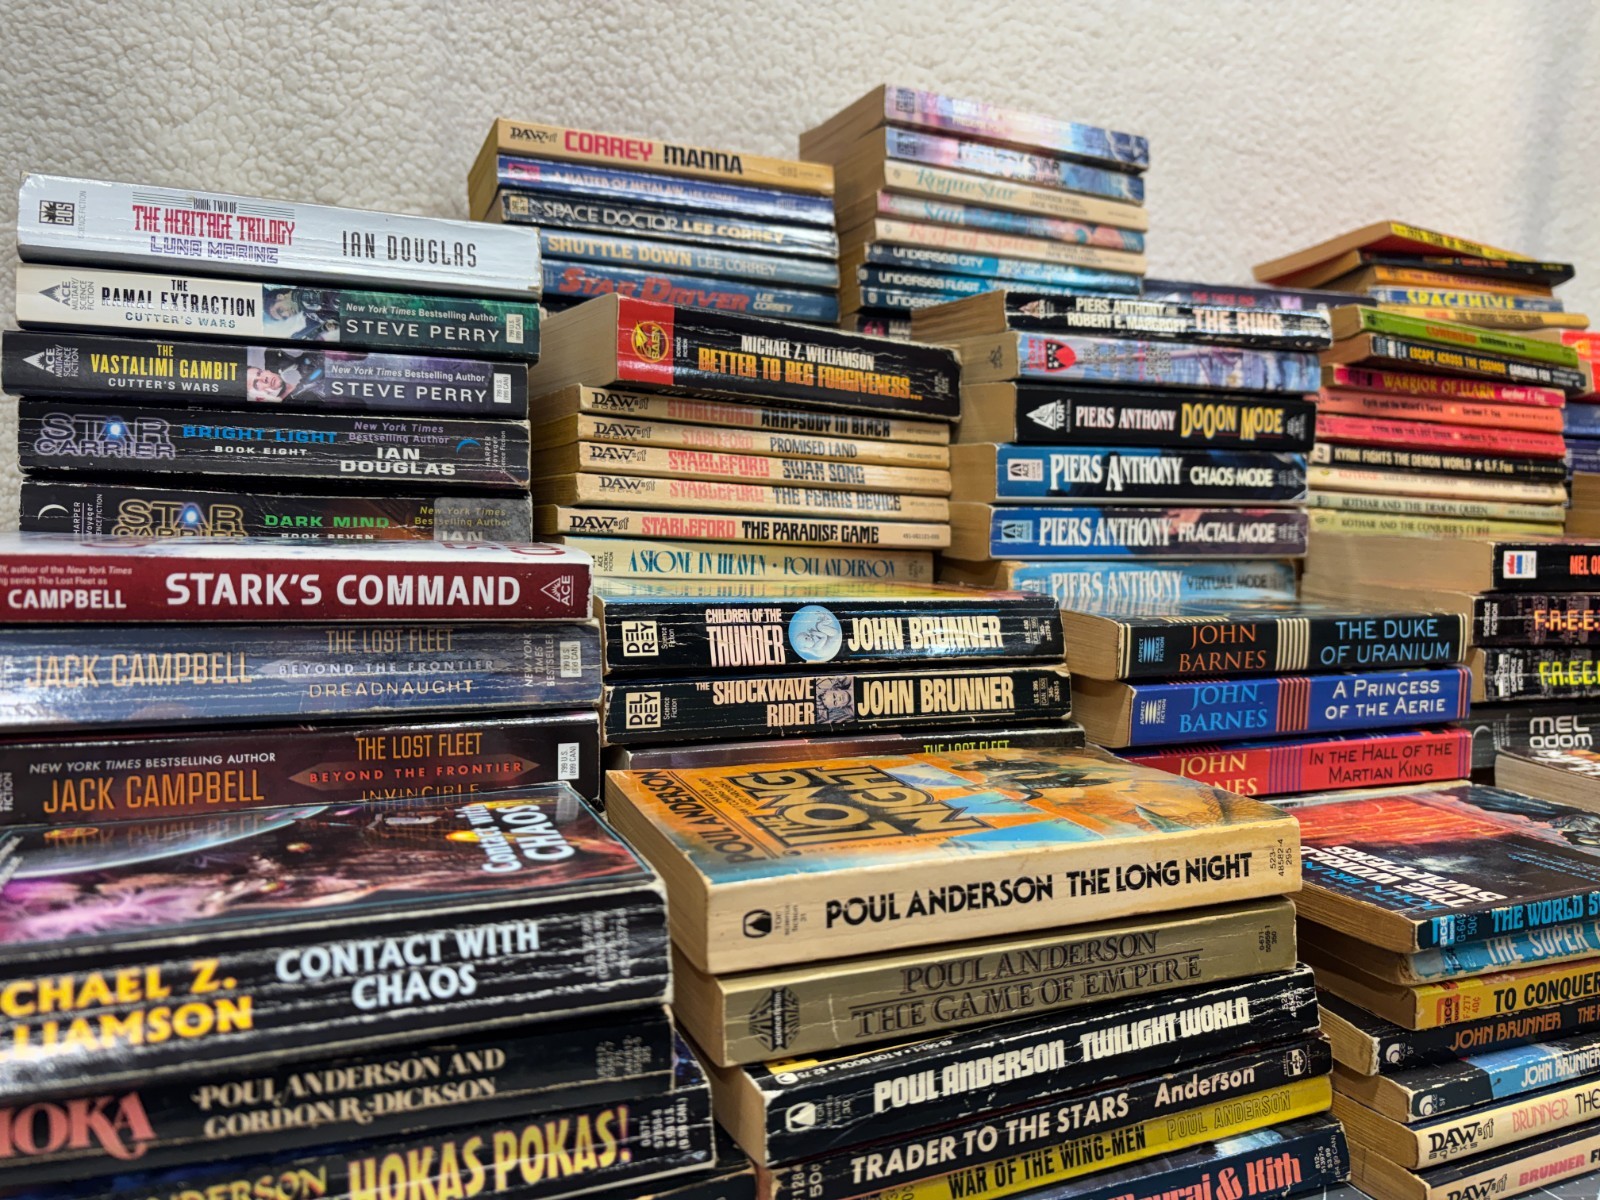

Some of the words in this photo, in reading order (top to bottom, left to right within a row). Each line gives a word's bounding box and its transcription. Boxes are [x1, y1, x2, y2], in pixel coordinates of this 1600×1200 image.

[564, 130, 654, 162] CORREY
[663, 145, 743, 174] MANNA
[213, 199, 226, 212] TWO
[226, 201, 238, 214] OF
[132, 204, 161, 233] THE
[164, 207, 233, 240] HERITAGE
[237, 215, 296, 246] TRILOGY
[543, 201, 599, 223] SPACE
[603, 209, 678, 232] DOCTOR
[682, 220, 714, 236] LEE
[716, 225, 785, 244] CORREY
[150, 235, 202, 257] LUNA
[207, 241, 279, 264] MARINE
[342, 230, 376, 259] IAN
[387, 235, 478, 268] DOUGLAS
[547, 235, 633, 260] SHUTTLE
[637, 245, 692, 267] DOWN
[697, 256, 723, 271] LEE
[725, 260, 777, 276] CORREY
[62, 281, 71, 306] ACE
[171, 279, 188, 292] THE
[160, 291, 256, 318] EXTRACTION
[345, 302, 366, 313] New
[368, 304, 387, 315] York
[390, 306, 416, 317] Times
[418, 308, 466, 322] Bestselling
[468, 311, 498, 323] Author
[125, 312, 193, 326] CUTTER'S
[198, 316, 236, 329] WARS
[346, 319, 419, 338] STEVE
[430, 324, 500, 343] PERRY
[1192, 309, 1231, 332] THE
[1236, 312, 1284, 336] RING
[156, 344, 174, 357] THE
[651, 326, 660, 359] BAEN
[741, 335, 792, 359] MICHAEL
[794, 344, 805, 361] Z.
[806, 345, 875, 371] WILLIAMSON
[90, 353, 174, 377] VASTALIMI
[179, 360, 238, 381] GAMBIT
[1409, 346, 1435, 363] ESCAPE
[1465, 355, 1477, 370] THE
[698, 347, 757, 378] BETTER
[761, 357, 781, 381] TO
[785, 360, 814, 386] BEG
[817, 365, 923, 401] FORGIVENESS...
[40, 411, 170, 444] STAR
[183, 424, 264, 441] BRIGHT
[275, 429, 337, 444] LIGHT
[1075, 405, 1116, 429] PIERS
[1118, 407, 1178, 431] ANTHONY
[1180, 402, 1238, 440] DOOON
[1240, 406, 1285, 441] MODE
[35, 438, 176, 460] CARRIER
[1362, 449, 1392, 465] FIGHTS
[1394, 450, 1410, 466] THE
[1411, 453, 1441, 469] DEMON
[1442, 455, 1472, 471] WORLD
[1049, 453, 1102, 491] PIERS
[1105, 454, 1183, 492] ANTHONY
[1188, 466, 1235, 487] CHAOS
[1235, 467, 1275, 487] MODE
[570, 515, 617, 530] DAW
[641, 516, 737, 539] STABLEFORD
[741, 520, 770, 540] THE
[772, 522, 839, 543] PARADISE
[841, 525, 880, 544] GAME
[1177, 521, 1236, 543] FRACTAL
[1237, 522, 1276, 544] MODE
[1569, 555, 1589, 575] MEL
[7, 588, 127, 609] CAMPBELL
[165, 572, 322, 606] STARK'S
[336, 574, 521, 606] COMMAND
[705, 608, 750, 623] CHILDREN
[752, 608, 763, 623] OF
[764, 607, 783, 623] THE
[1335, 620, 1377, 640] THE
[1383, 619, 1439, 639] DUKE
[705, 625, 786, 667] THUNDER
[847, 616, 904, 652] JOHN
[908, 615, 1004, 650] BRUNNER
[1190, 623, 1257, 649] JOHN
[1178, 649, 1267, 672] BARNES
[1320, 645, 1350, 665] OF
[1357, 642, 1451, 664] URANIUM
[309, 679, 474, 698] DREADNAUGHT
[695, 682, 711, 692] THE
[712, 677, 815, 706] SHOCKWAVE
[1332, 680, 1348, 699] A
[1353, 679, 1441, 698] PRINCESS
[766, 702, 816, 728] RIDER
[1324, 705, 1350, 721] OF
[1355, 702, 1389, 717] THE
[1393, 697, 1446, 715] AERIE
[355, 736, 387, 761] THE
[393, 734, 432, 759] LOST
[438, 732, 483, 757] FLEET
[1308, 748, 1324, 766] IN
[1329, 750, 1357, 763] THE
[1361, 743, 1399, 761] HALL
[1402, 744, 1423, 759] OF
[1423, 742, 1453, 757] THE
[29, 762, 62, 774] NEW
[66, 760, 101, 772] YORK
[105, 758, 142, 770] TIMES
[145, 754, 223, 768] BESTSELLING
[227, 752, 276, 764] AUTHOR
[1328, 764, 1393, 784] MARTIAN
[1398, 760, 1434, 778] KING
[43, 776, 115, 813] JACK
[125, 769, 265, 809] CAMPBELL
[825, 891, 901, 929] POUL
[906, 873, 1054, 920] ANDERSON
[1066, 870, 1110, 898] THE
[1115, 859, 1180, 892] LONG
[1185, 852, 1253, 885] NIGHT
[1491, 905, 1525, 933] THE
[1527, 894, 1584, 927] WORLD
[275, 932, 446, 983] CONTACT
[454, 921, 540, 959] WITH
[352, 963, 478, 1010] CHAOS
[851, 1000, 927, 1039] THE
[930, 982, 1029, 1024] GAME
[1037, 970, 1074, 1005] OF
[1079, 954, 1205, 1000] EMPIRE
[1493, 987, 1517, 1013] TO
[1523, 971, 1600, 1007] CONQUER
[873, 1068, 941, 1114] POUL
[942, 1038, 1068, 1096] ANDERSON
[1079, 1011, 1178, 1063] TWILIGHT
[1179, 996, 1251, 1039] WORLD
[191, 1078, 281, 1110] POUL
[286, 1054, 441, 1097] ANDERSON
[446, 1048, 506, 1076] AND
[851, 1134, 957, 1185] TRADER
[961, 1124, 998, 1153] TO
[1004, 1117, 1050, 1146] THE
[1056, 1092, 1130, 1135] STARS
[1153, 1065, 1256, 1109] Anderson
[1428, 1121, 1481, 1153] DAW
[1511, 1097, 1570, 1133] BRUNNER
[1575, 1088, 1600, 1115] THE
[348, 1136, 487, 1200] HOKAS
[492, 1105, 631, 1193] POKAS!
[1518, 1153, 1586, 1187] BRUNNER
